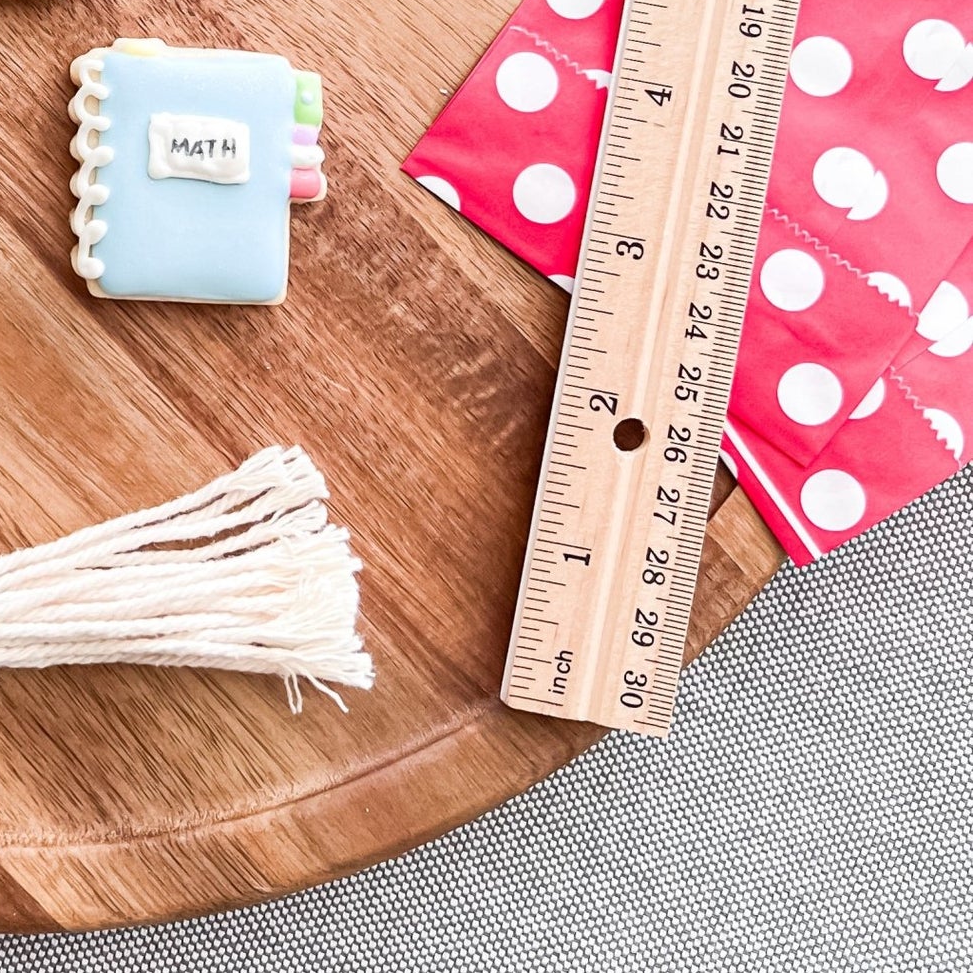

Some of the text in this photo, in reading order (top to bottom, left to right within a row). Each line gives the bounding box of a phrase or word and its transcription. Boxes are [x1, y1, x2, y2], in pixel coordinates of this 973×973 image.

[738, 4, 765, 38] 19
[644, 88, 672, 107] 4
[727, 61, 755, 99] 20
[171, 138, 236, 161] MATH
[717, 123, 744, 157] 21
[705, 181, 734, 220] 22
[615, 240, 645, 261] 3
[695, 241, 723, 281] 23
[685, 302, 712, 340] 24
[674, 363, 702, 403] 25
[589, 393, 619, 416] 2
[663, 423, 691, 464] 26
[653, 485, 680, 527] 27
[563, 550, 591, 566] 1
[642, 546, 670, 585] 28
[631, 608, 658, 647] 29
[548, 650, 574, 694] inch
[620, 671, 648, 709] 30
